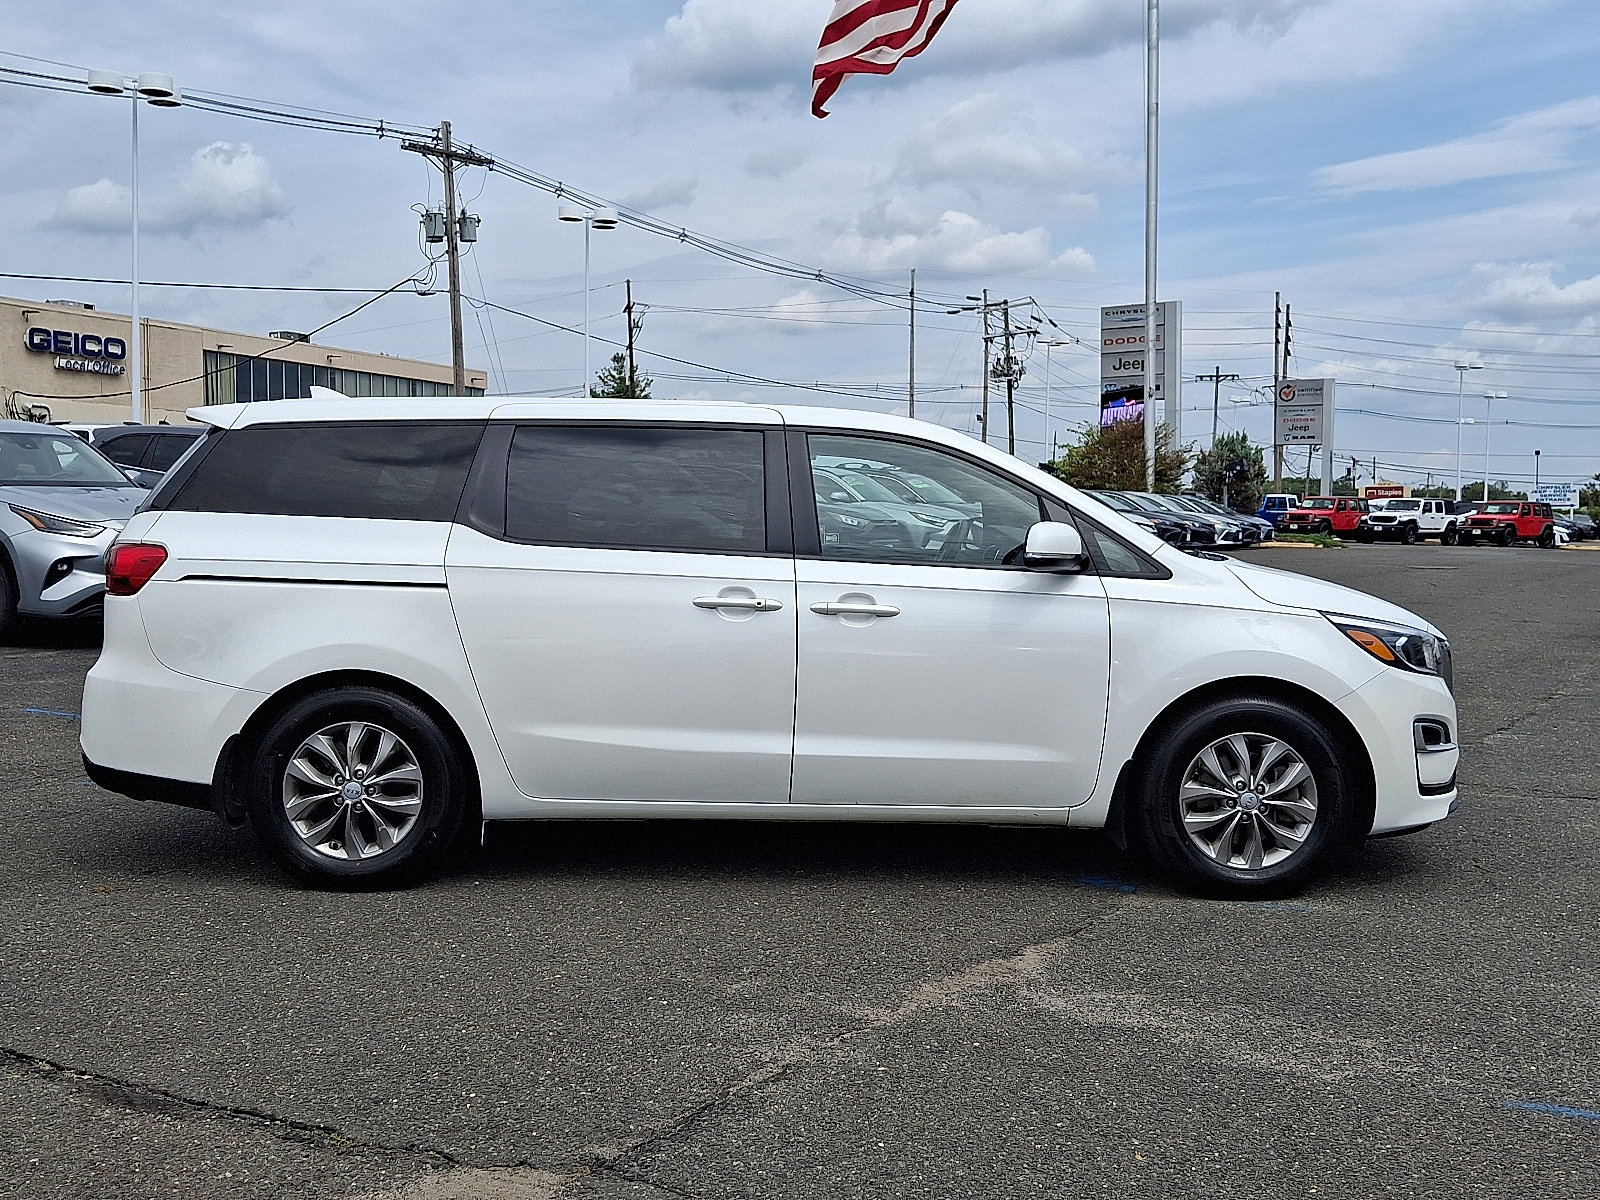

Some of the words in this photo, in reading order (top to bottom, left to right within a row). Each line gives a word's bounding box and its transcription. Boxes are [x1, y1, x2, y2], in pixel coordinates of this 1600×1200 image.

[1104, 308, 1160, 317] CHRYSL
[26, 326, 127, 360] GEICO
[55, 357, 89, 372] Local
[92, 360, 126, 376] Office
[1288, 424, 1310, 432] Jeep
[1377, 489, 1402, 497] Staples
[346, 787, 361, 795] KIA
